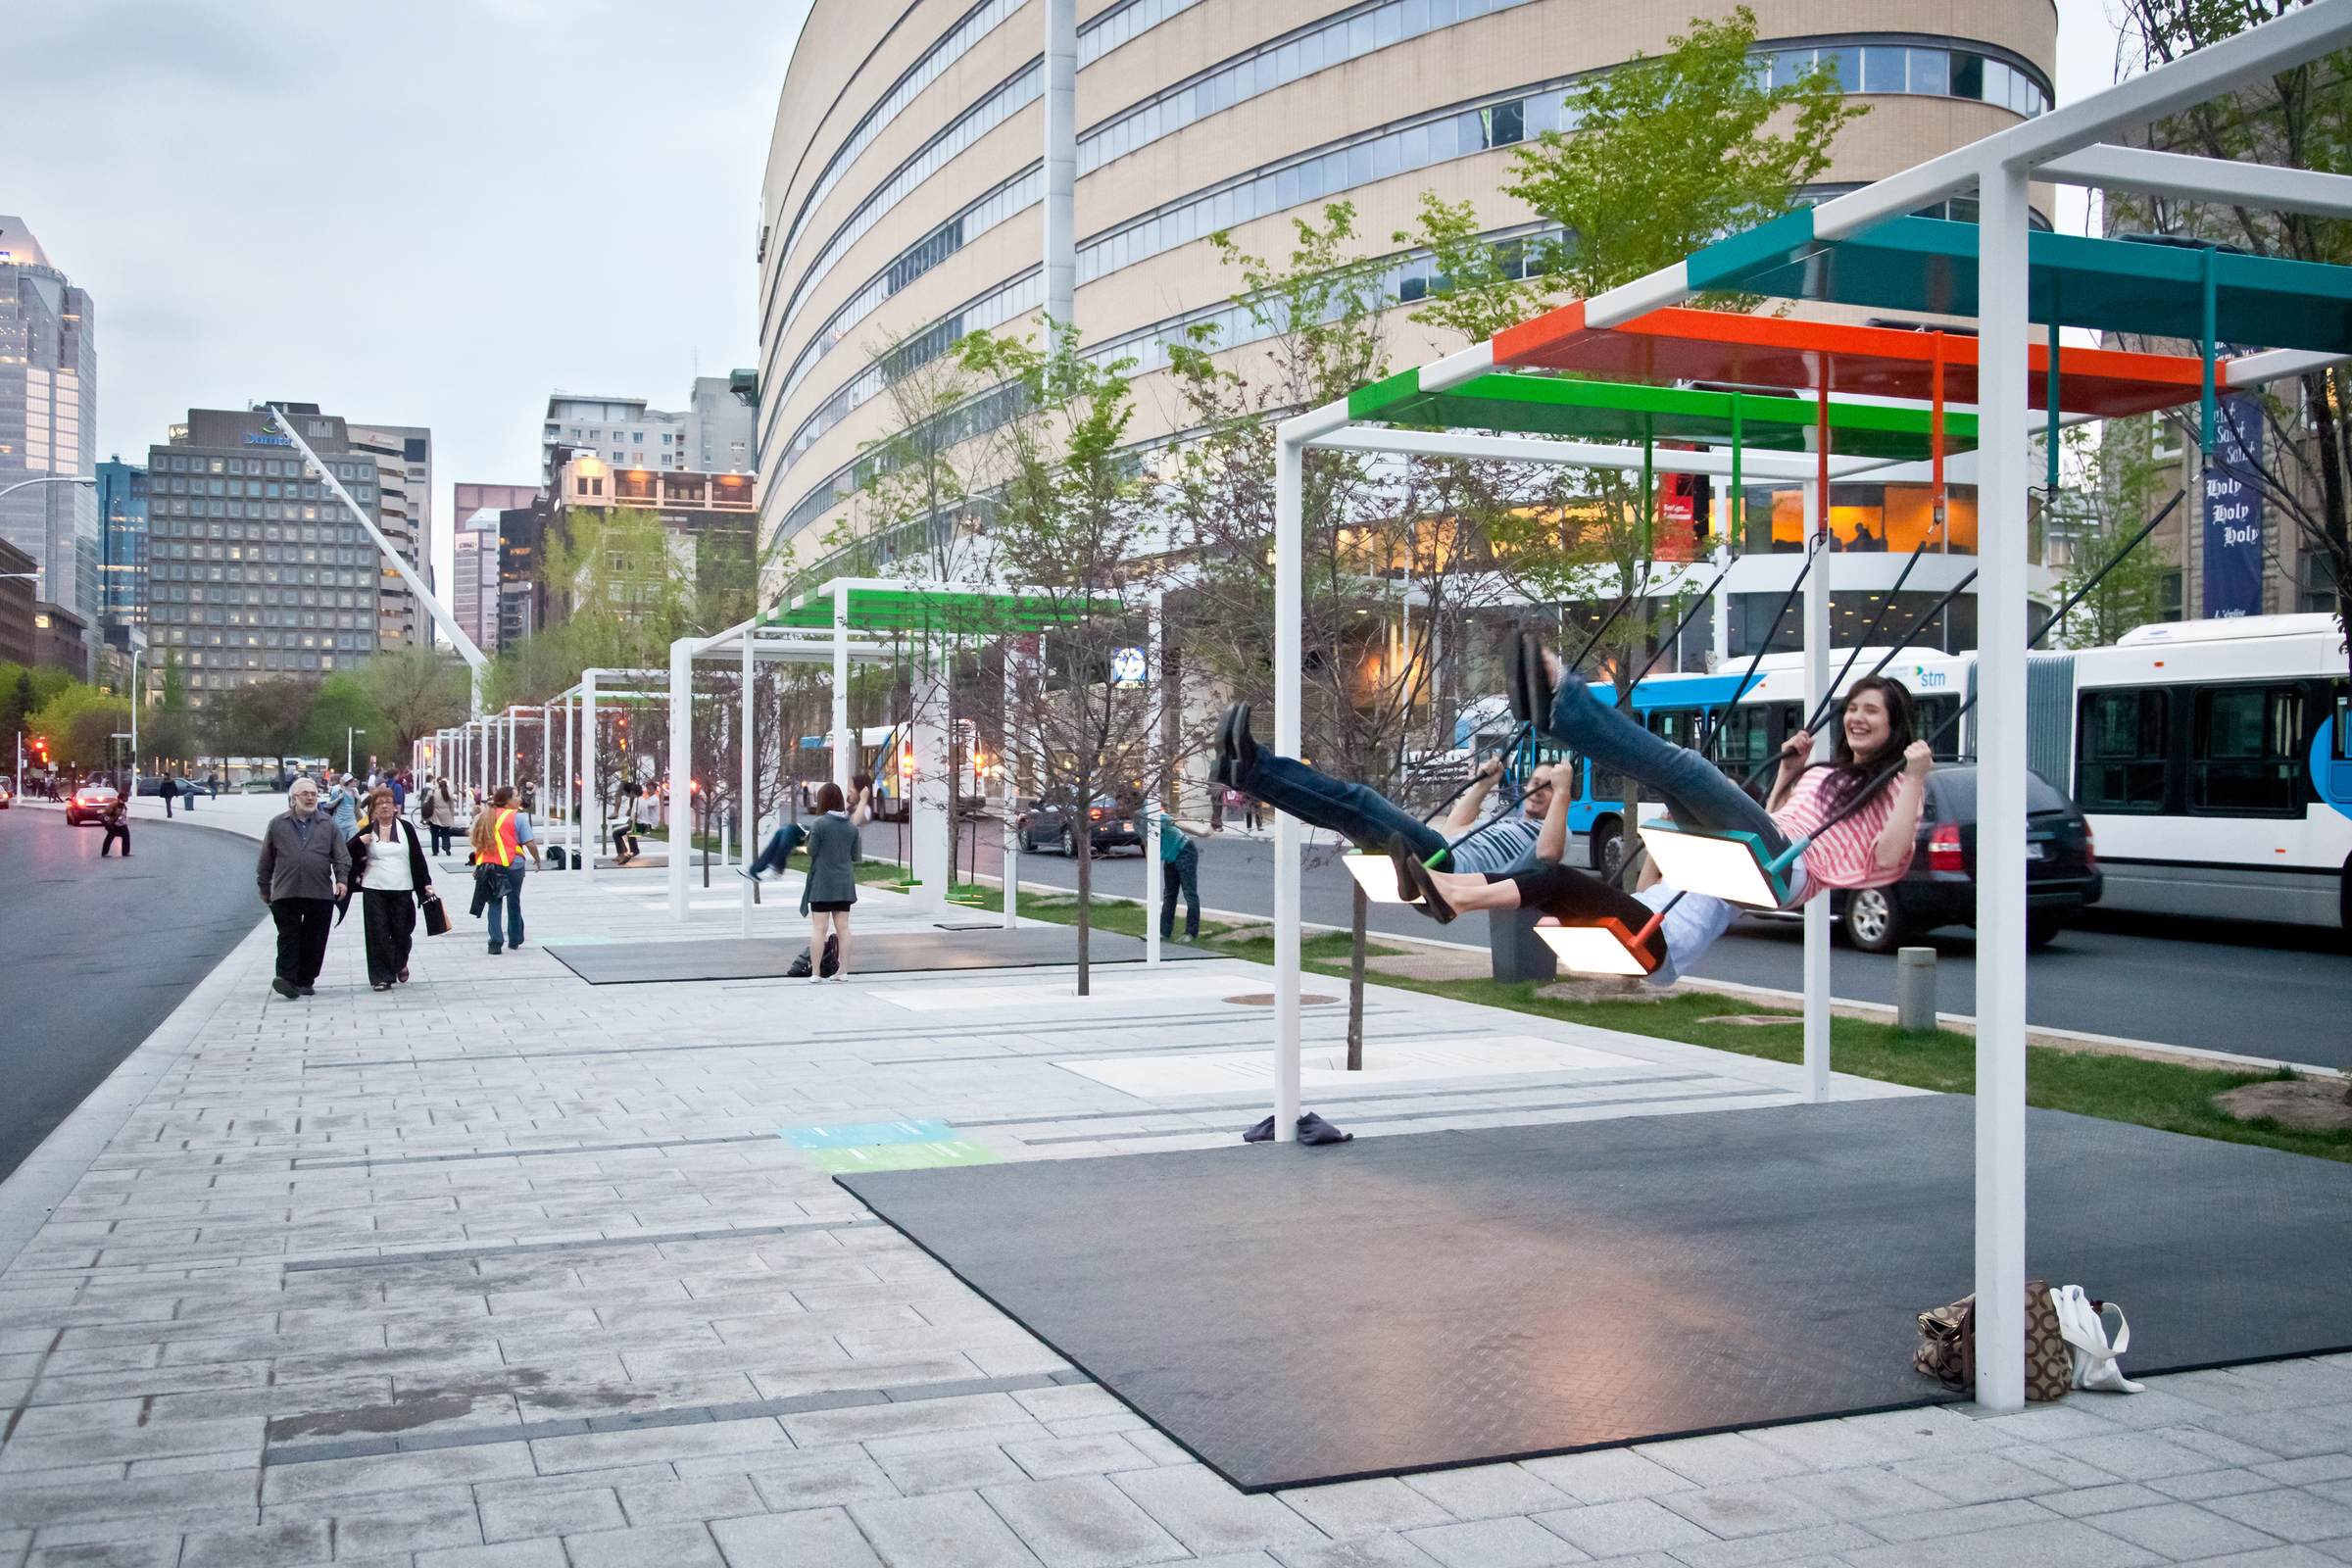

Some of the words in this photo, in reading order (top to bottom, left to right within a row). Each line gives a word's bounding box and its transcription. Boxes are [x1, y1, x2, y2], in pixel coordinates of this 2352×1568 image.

[243, 432, 292, 446] Domta
[2206, 477, 2242, 500] Holy
[2212, 502, 2249, 525] Holy
[2224, 524, 2260, 548] Holy
[1921, 670, 1946, 687] stm
